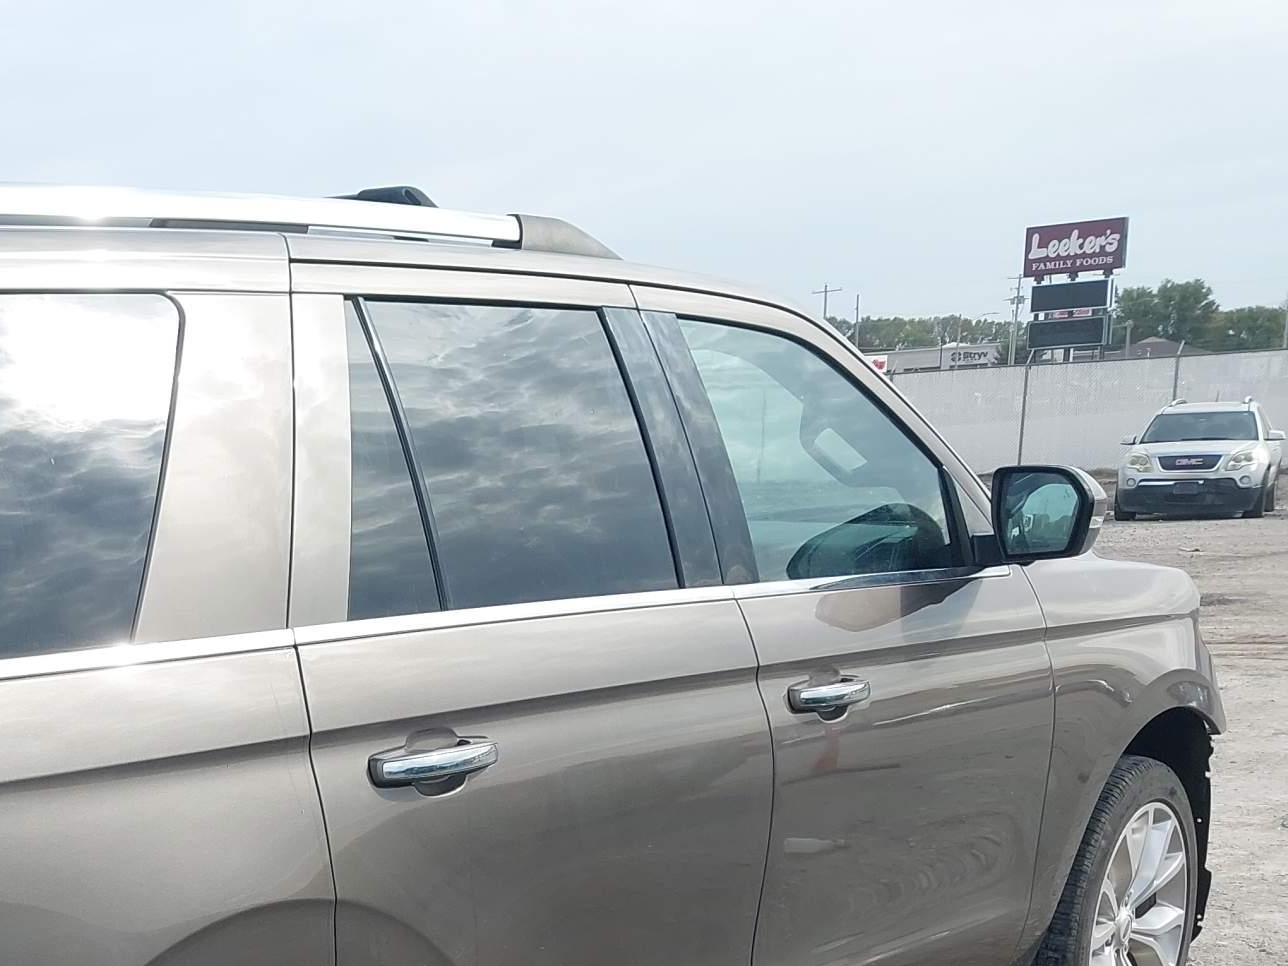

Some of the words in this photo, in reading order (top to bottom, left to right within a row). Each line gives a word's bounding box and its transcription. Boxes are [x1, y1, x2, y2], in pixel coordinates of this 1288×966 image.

[1028, 228, 1121, 260] Leeker's
[1031, 259, 1073, 271] FAMILY
[1076, 255, 1114, 267] FOODS
[1175, 458, 1203, 466] GMC
